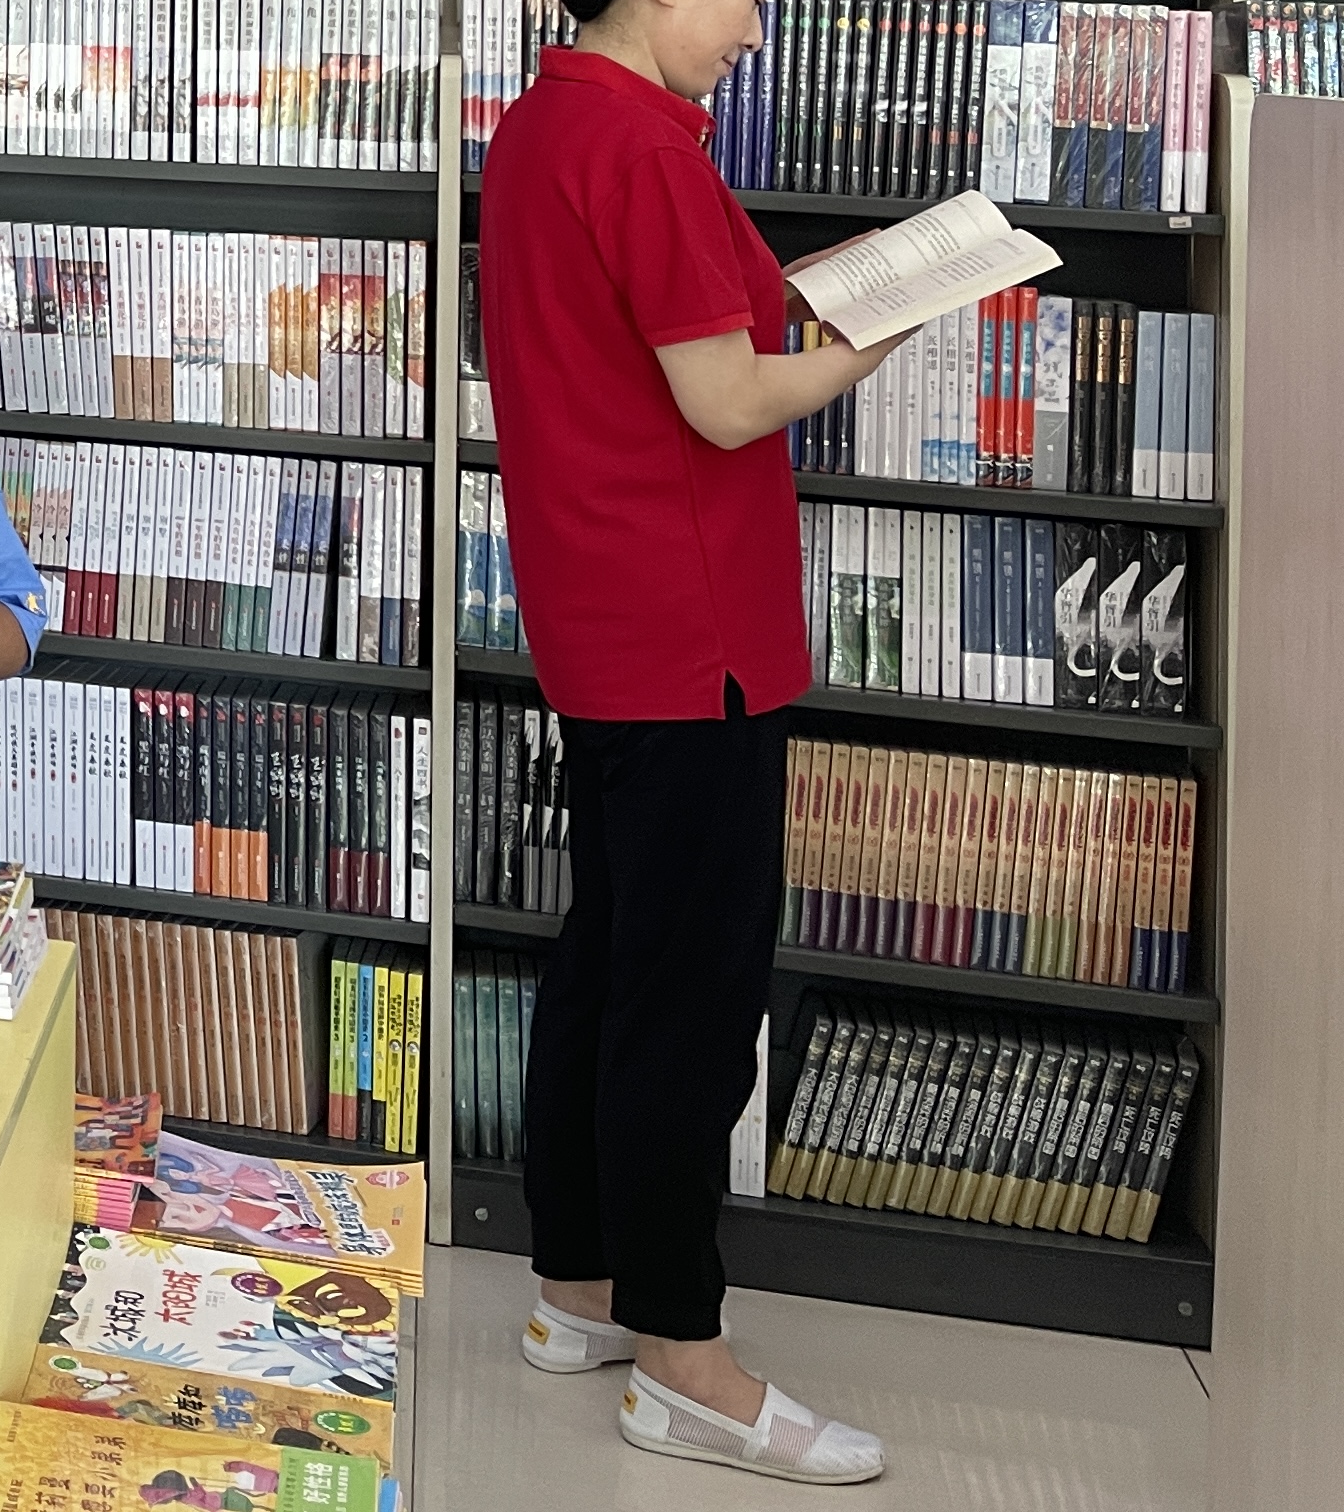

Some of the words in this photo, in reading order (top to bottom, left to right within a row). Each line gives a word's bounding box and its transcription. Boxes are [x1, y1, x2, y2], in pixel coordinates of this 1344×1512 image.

[101, 1290, 146, 1342] 冰城和
[155, 1268, 202, 1326] 太阳城
